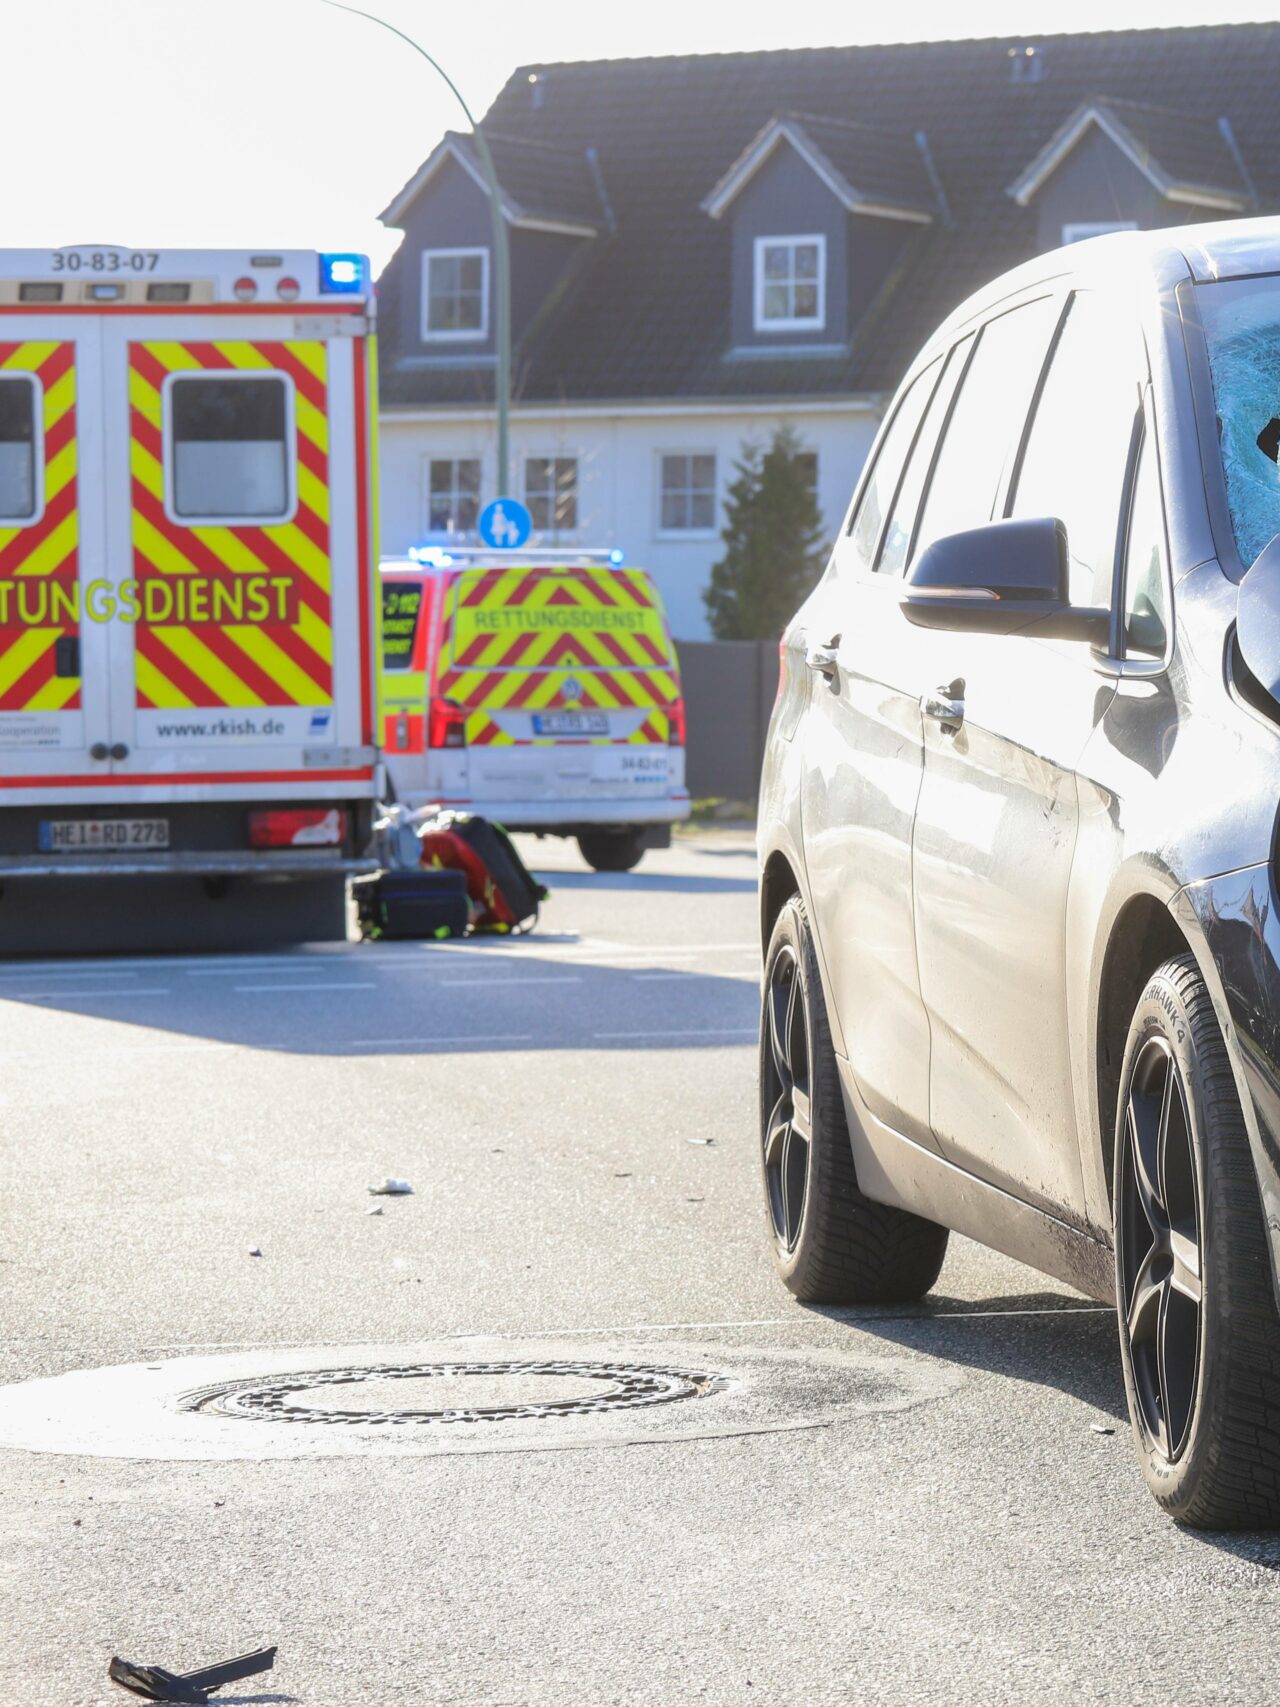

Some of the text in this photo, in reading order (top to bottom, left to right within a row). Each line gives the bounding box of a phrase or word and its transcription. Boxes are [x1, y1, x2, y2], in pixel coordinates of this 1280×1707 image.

[51, 252, 161, 272] 30-83-07
[474, 610, 646, 629] RETTUNGSDIENST
[156, 717, 285, 737] www.rkish.de
[103, 822, 128, 845] RD
[132, 821, 167, 843] 278
